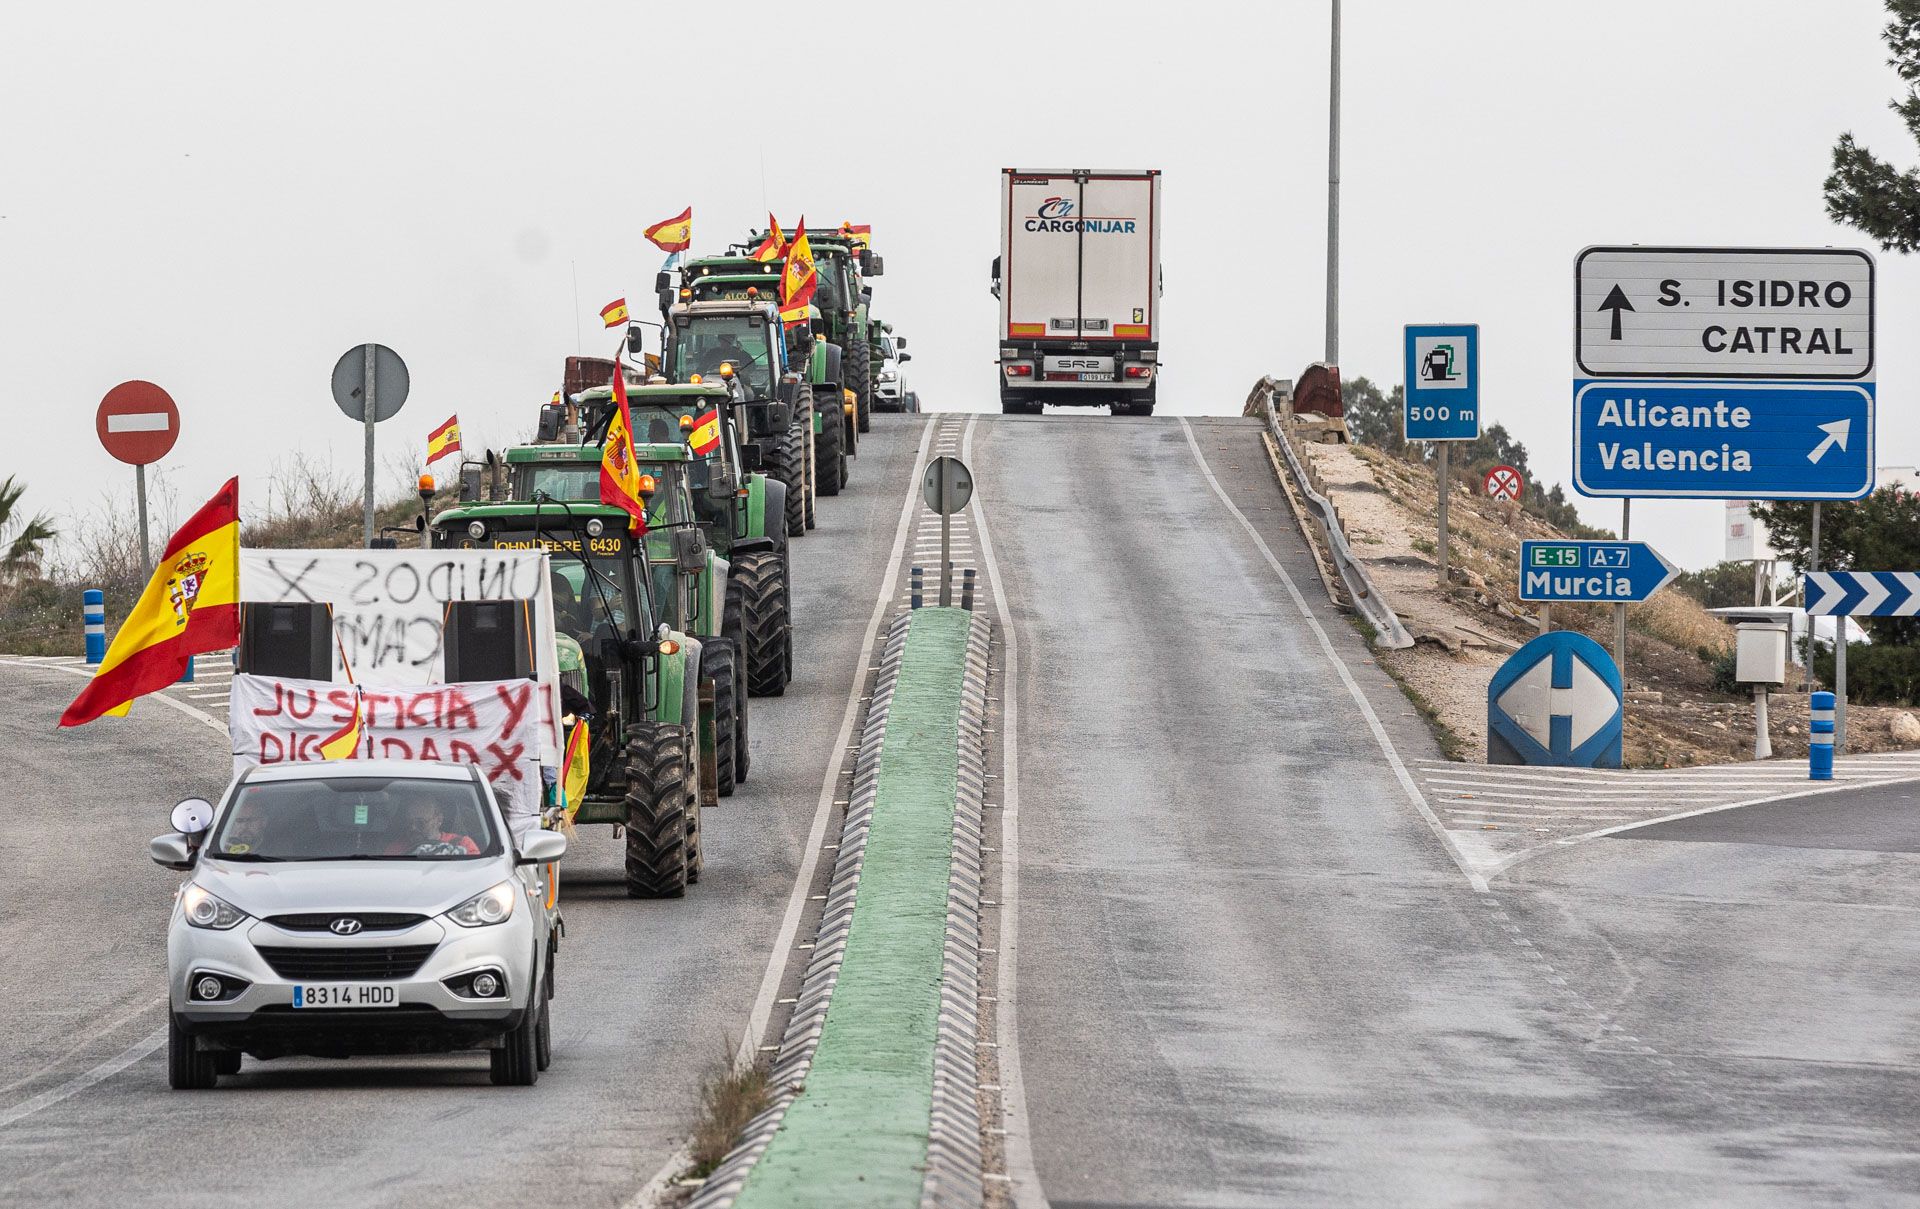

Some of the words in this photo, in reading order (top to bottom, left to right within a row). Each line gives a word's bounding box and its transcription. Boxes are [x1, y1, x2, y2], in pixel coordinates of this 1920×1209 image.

[1025, 219, 1136, 234] CARGONIJAR
[723, 292, 774, 301] ALCOANO
[1657, 279, 1690, 307] S.
[1718, 279, 1852, 308] ISIDRO
[1702, 326, 1853, 355] CATRAL
[1410, 407, 1450, 421] 500
[1460, 411, 1474, 421] m
[1597, 399, 1751, 428] Alicante
[1599, 443, 1752, 472] Valencia
[590, 538, 621, 552] 6430
[1535, 550, 1576, 565] E-15
[1592, 549, 1626, 566] A-7
[1526, 572, 1632, 596] Murcia
[260, 732, 481, 764] DIGIDAD
[306, 987, 352, 1004] 8314
[359, 986, 394, 1004] HDD
